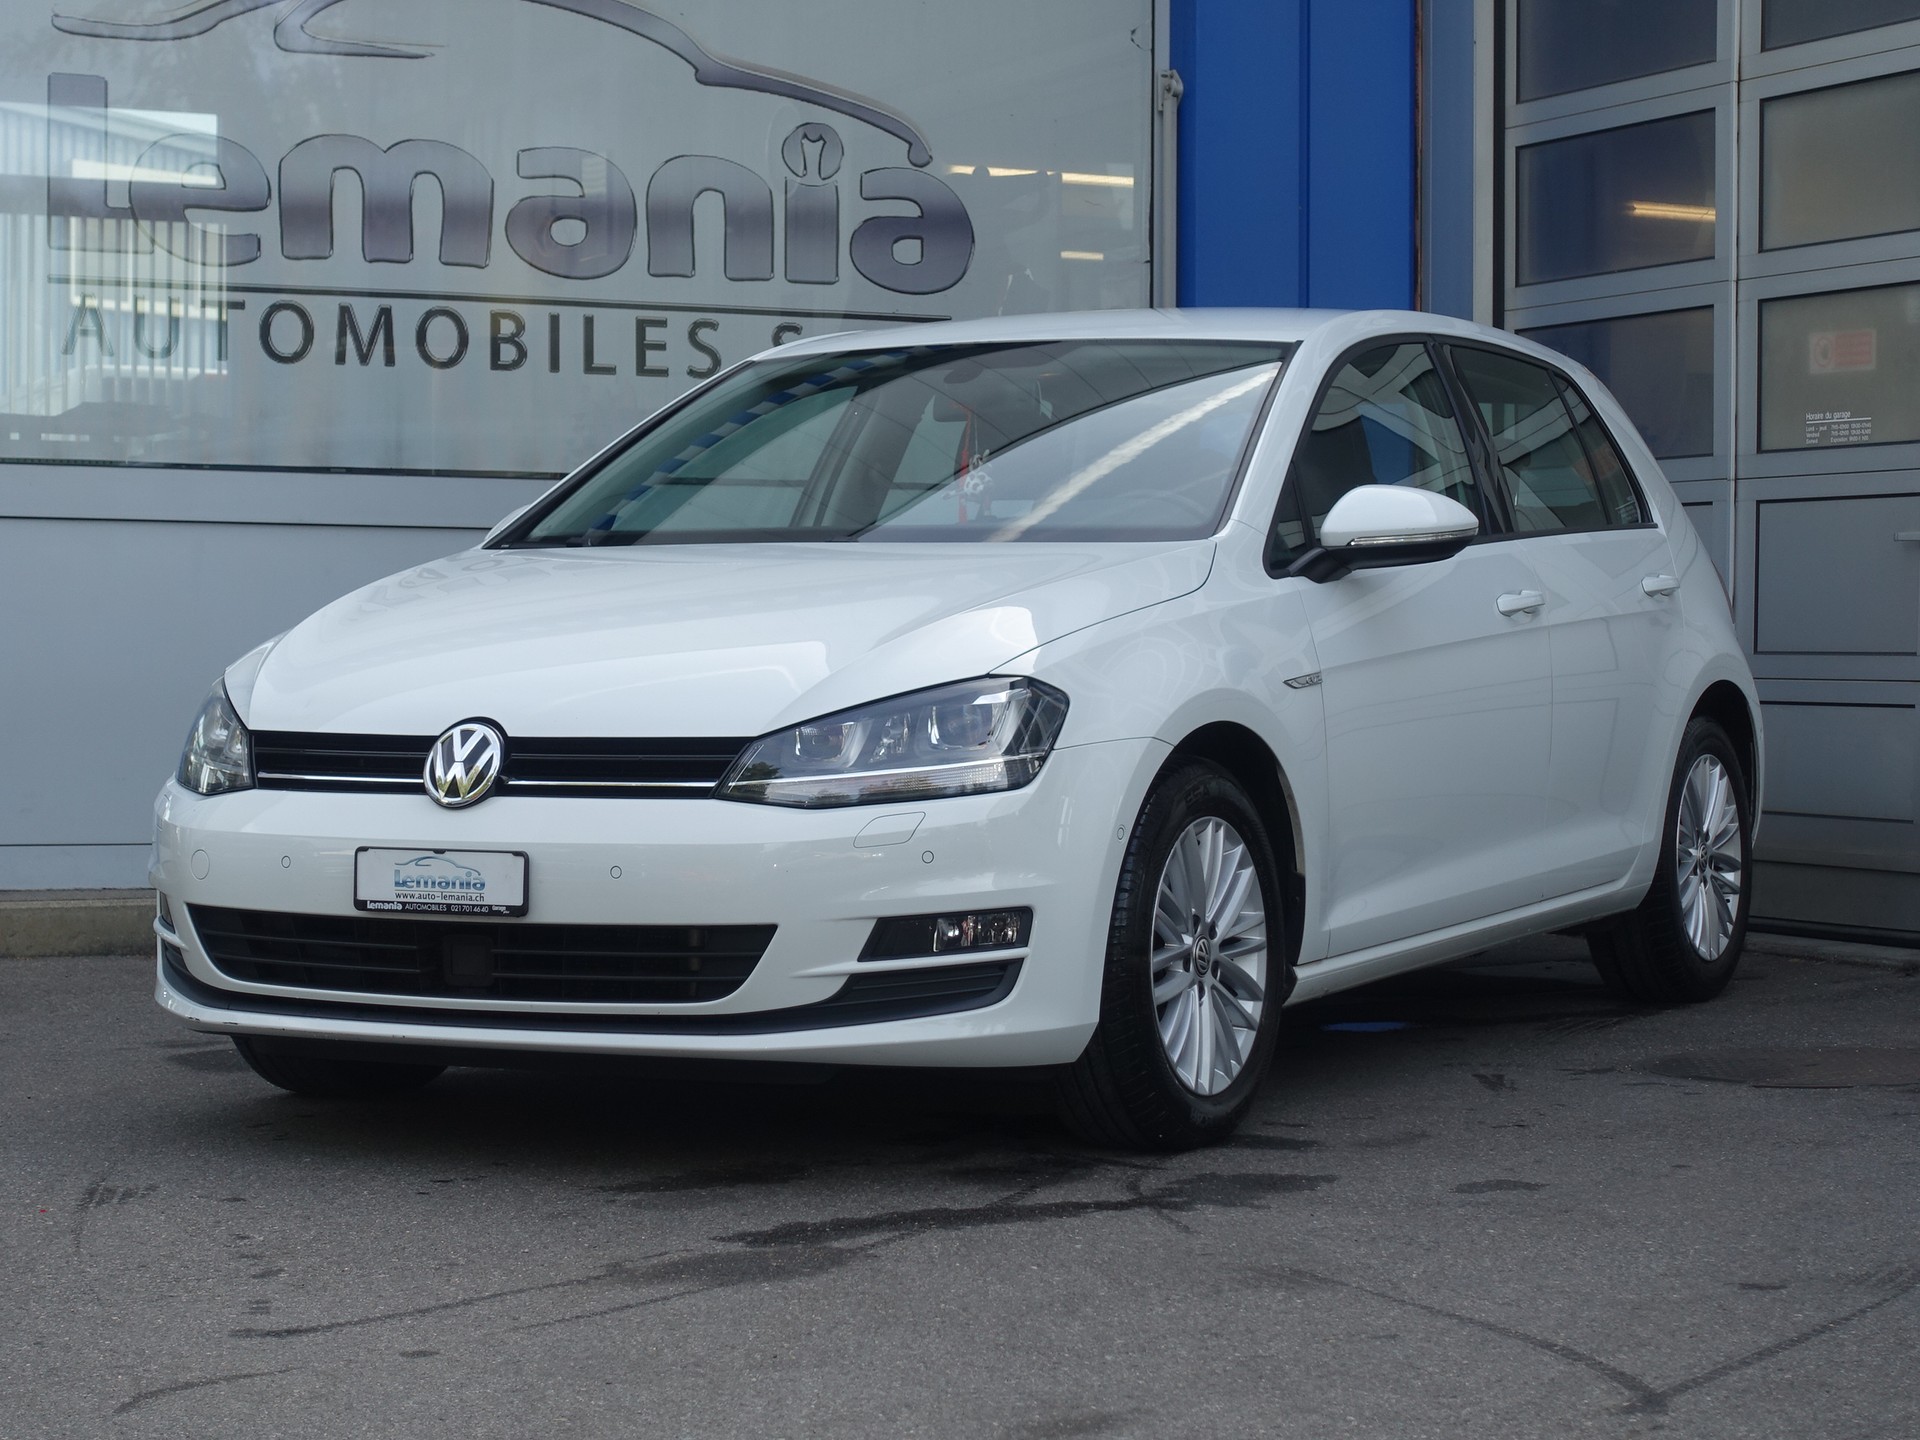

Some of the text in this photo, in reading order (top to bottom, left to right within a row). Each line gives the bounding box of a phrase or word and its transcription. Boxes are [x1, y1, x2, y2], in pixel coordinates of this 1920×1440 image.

[48, 73, 975, 295] Lemania
[61, 292, 722, 379] AUTOMOBILES
[394, 869, 486, 891] Lemania
[367, 900, 403, 910] Lemania
[405, 903, 447, 912] AUTOMOBILES
[395, 892, 485, 902] www.auto-lemania.ch
